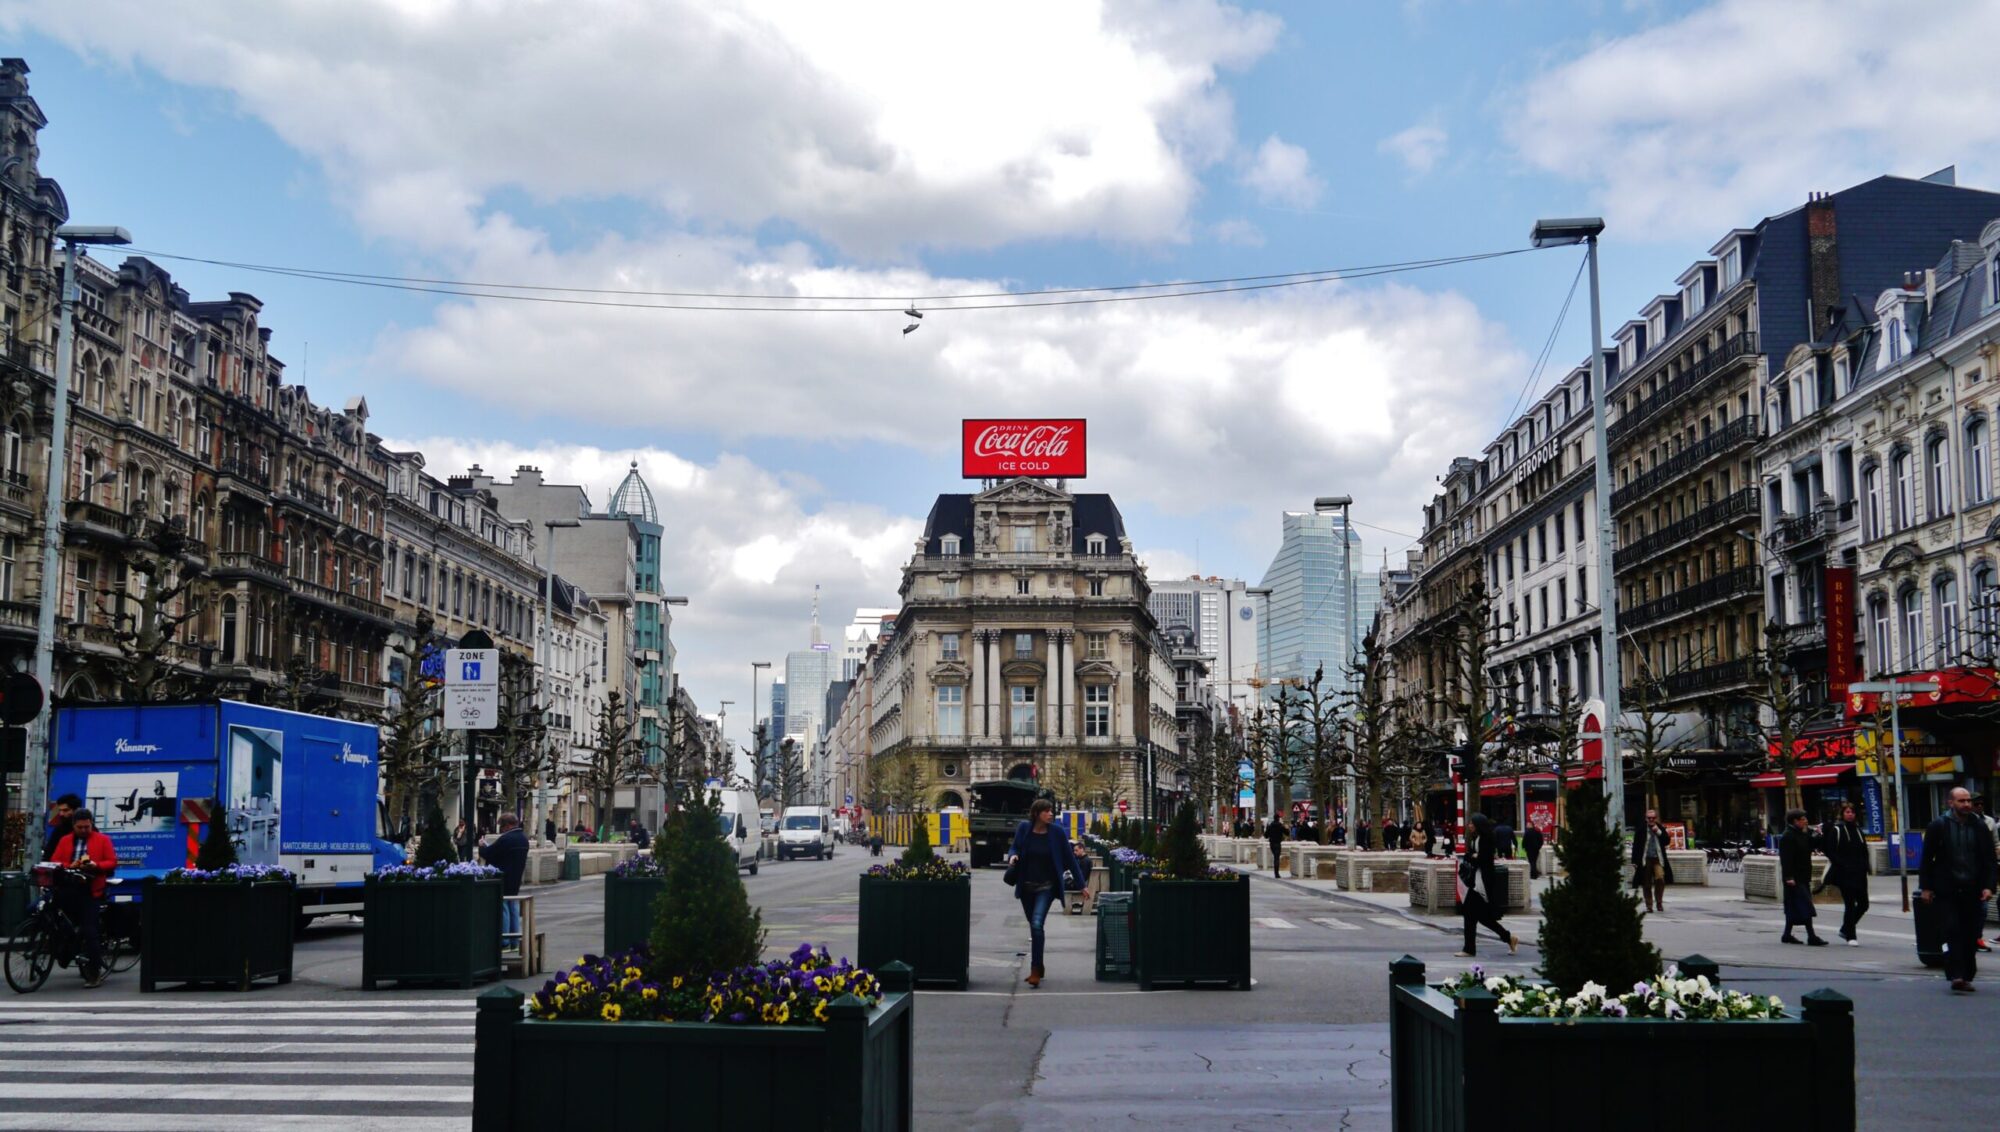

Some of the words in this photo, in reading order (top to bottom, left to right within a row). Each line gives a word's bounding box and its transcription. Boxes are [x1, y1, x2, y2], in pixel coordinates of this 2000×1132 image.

[974, 425, 1074, 457] Coca-Cola
[998, 462, 1016, 470] ICE
[1019, 462, 1050, 470] COLD
[1512, 437, 1559, 486] METROPOLE
[1835, 581, 1845, 676] BRUSSELS
[459, 652, 485, 660] ZONE
[115, 738, 163, 754] Kinnarps
[342, 742, 373, 768] Kinnarps
[1667, 757, 1697, 767] ALFREDO
